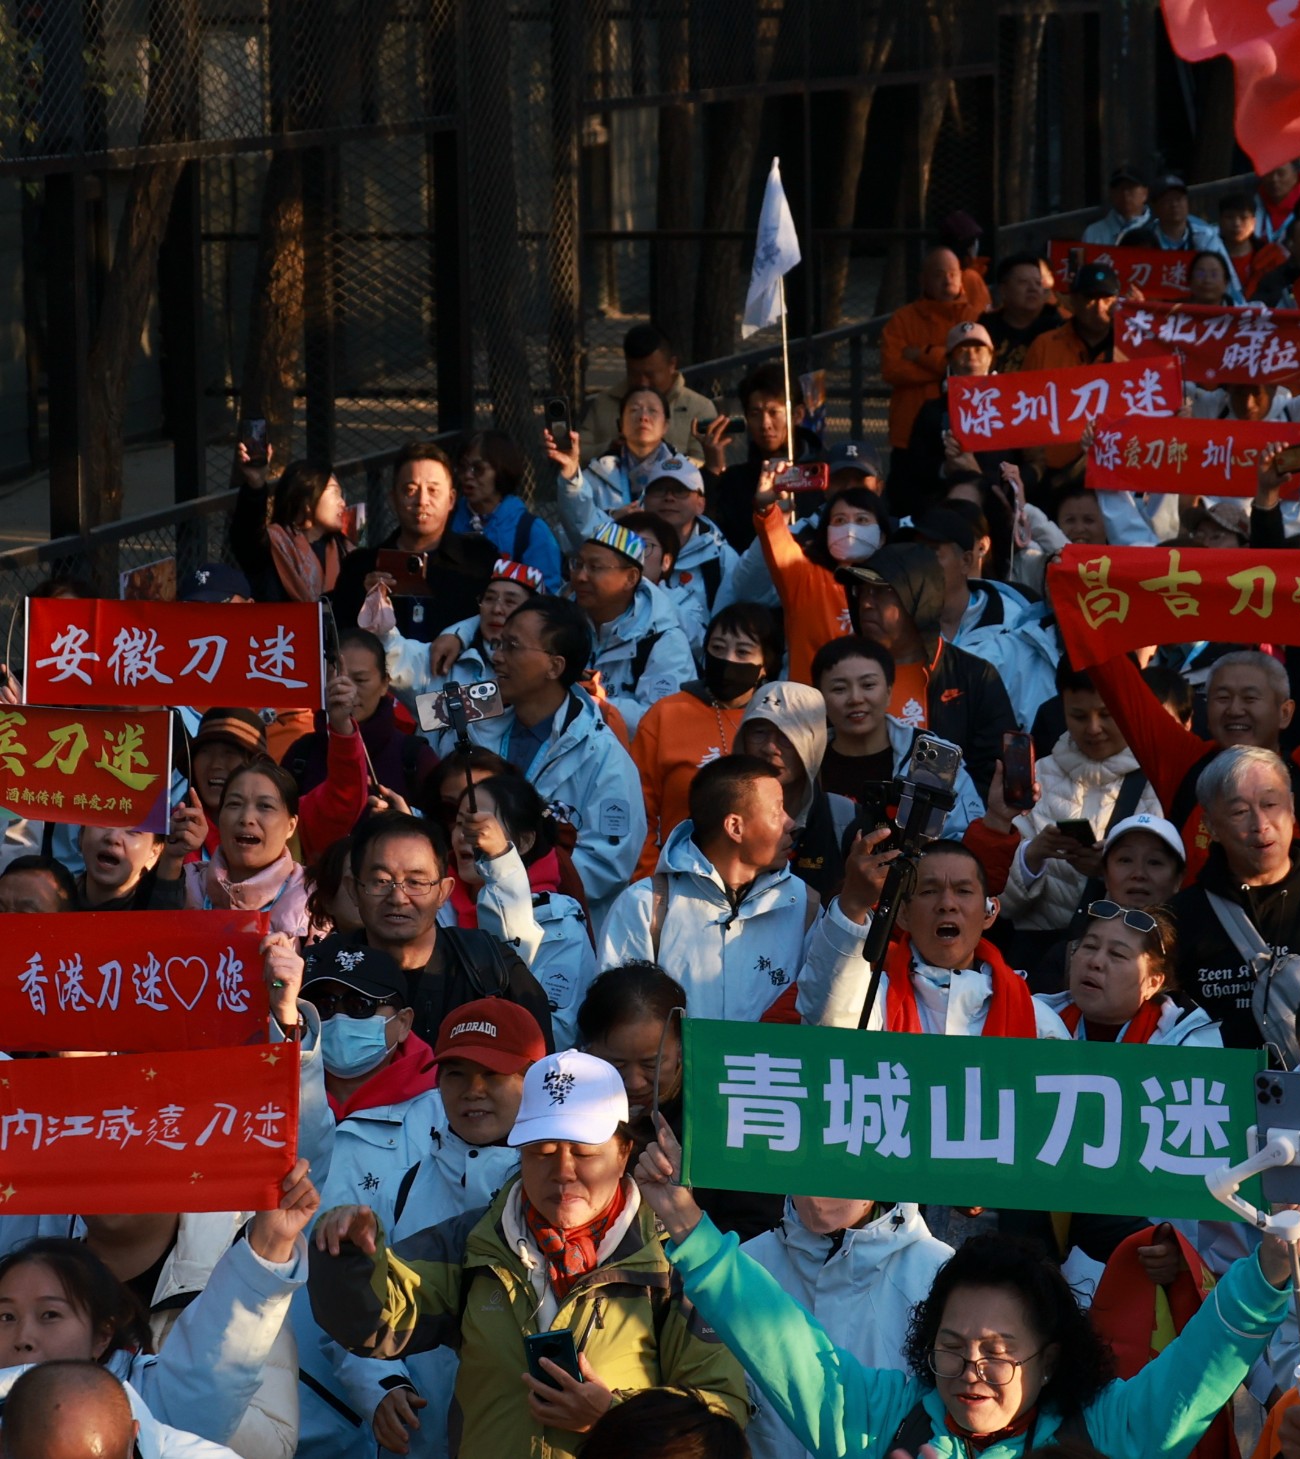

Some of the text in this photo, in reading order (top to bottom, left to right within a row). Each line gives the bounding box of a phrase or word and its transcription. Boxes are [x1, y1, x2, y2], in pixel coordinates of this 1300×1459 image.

[957, 367, 1174, 438] 深圳刀迷
[1093, 428, 1189, 473] 深爱刀郎
[36, 624, 309, 689] 安徽刀迷
[6, 787, 133, 814] 酒都传情 醉爱刀郎
[449, 1021, 498, 1039] COLORADO
[718, 1053, 1232, 1176] 青城山刀迷
